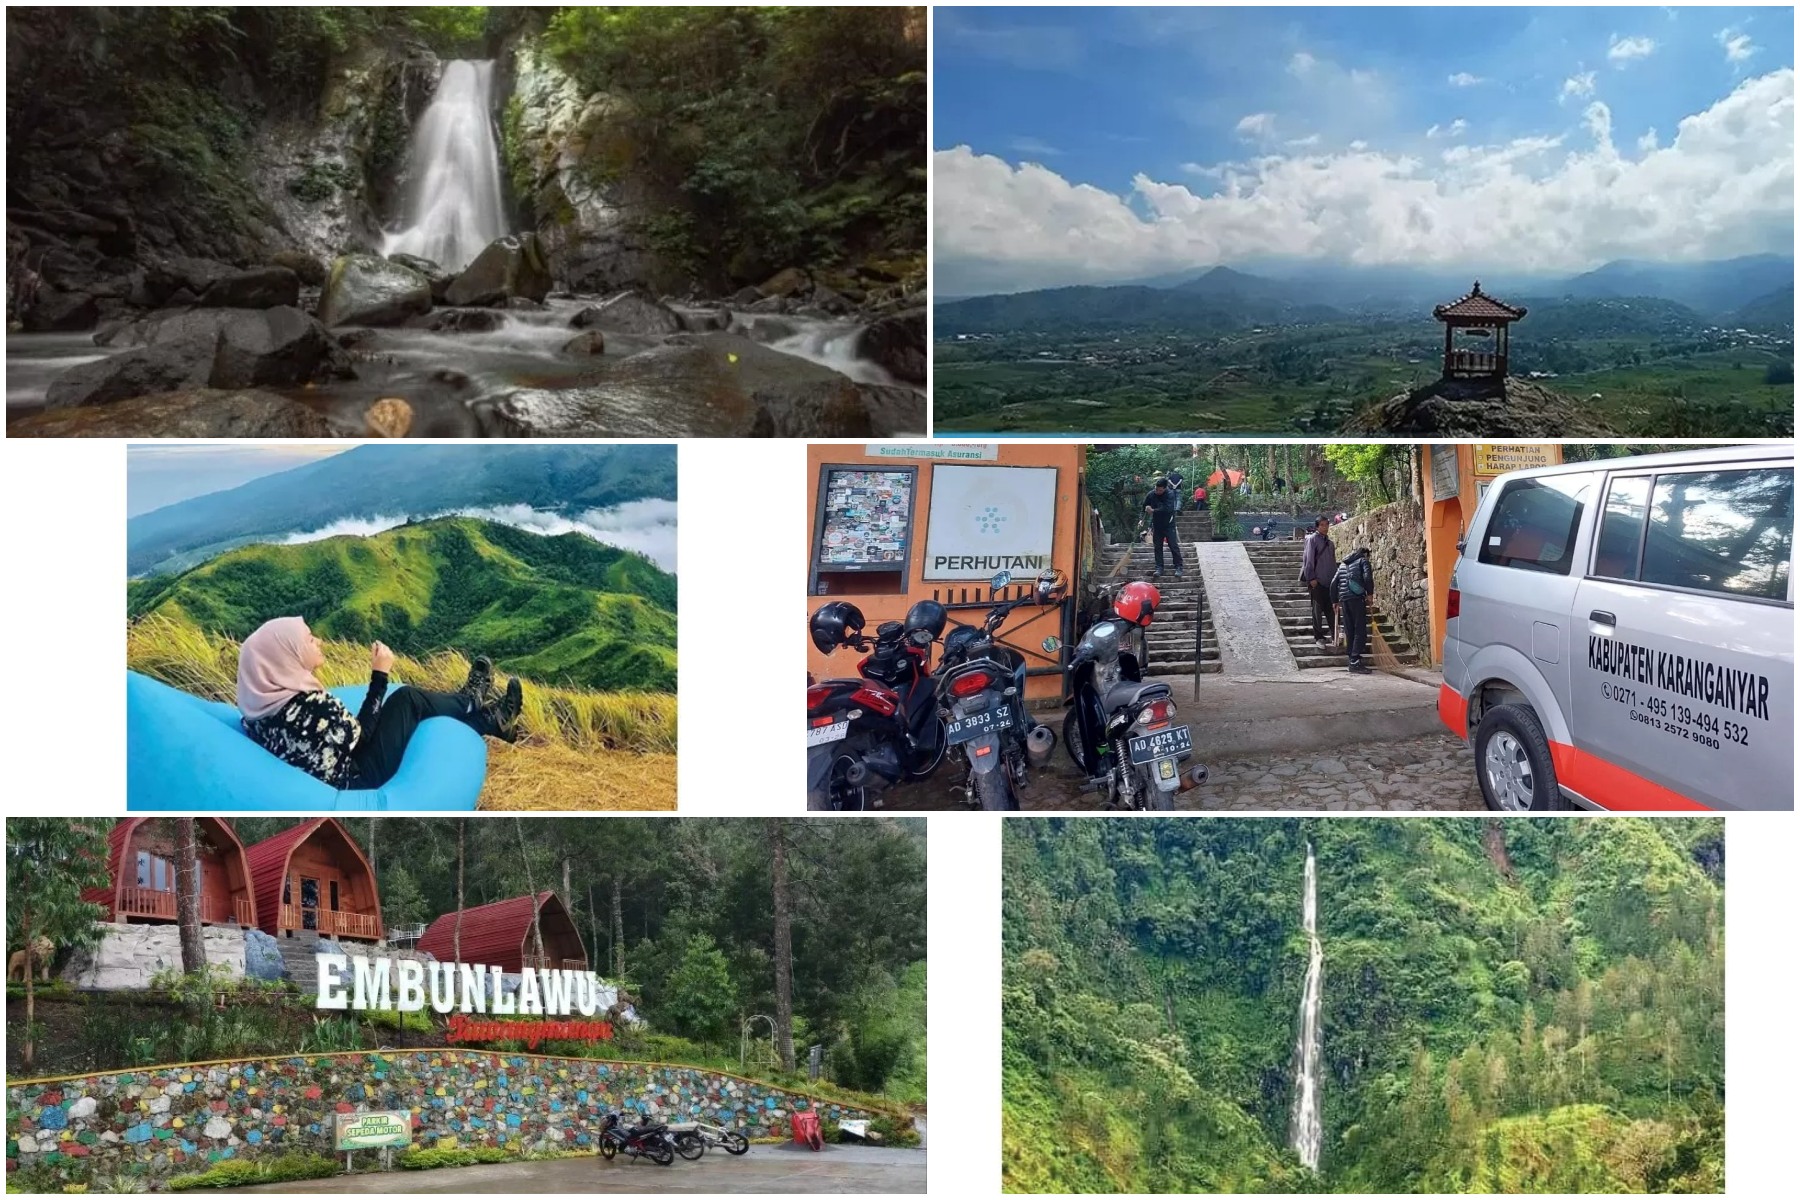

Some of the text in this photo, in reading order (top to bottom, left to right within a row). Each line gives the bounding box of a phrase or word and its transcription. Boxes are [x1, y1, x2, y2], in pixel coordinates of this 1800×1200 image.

[947, 450, 982, 459] Asuransi
[1491, 445, 1541, 454] PERHATIAN
[1486, 454, 1547, 463] PENGUNJUNG
[1486, 462, 1517, 470] HARAP
[934, 556, 1043, 570] PERHUTANI
[1588, 635, 1769, 721] KABUPATEN KARANGANYAR
[948, 706, 1009, 735] AD 3833 SZ
[1613, 685, 1636, 707] 0271
[1647, 696, 1667, 717] 495
[1723, 720, 1749, 746] 532
[807, 726, 827, 738] 787
[1664, 722, 1690, 739] 2572
[1692, 732, 1720, 750] 9080
[1134, 739, 1147, 752] AD
[1176, 728, 1188, 741] KT
[316, 953, 597, 1017] EMBUNLAWU
[361, 1115, 389, 1127] PARKIR
[346, 1124, 403, 1138] SEPEDA MOTOR
